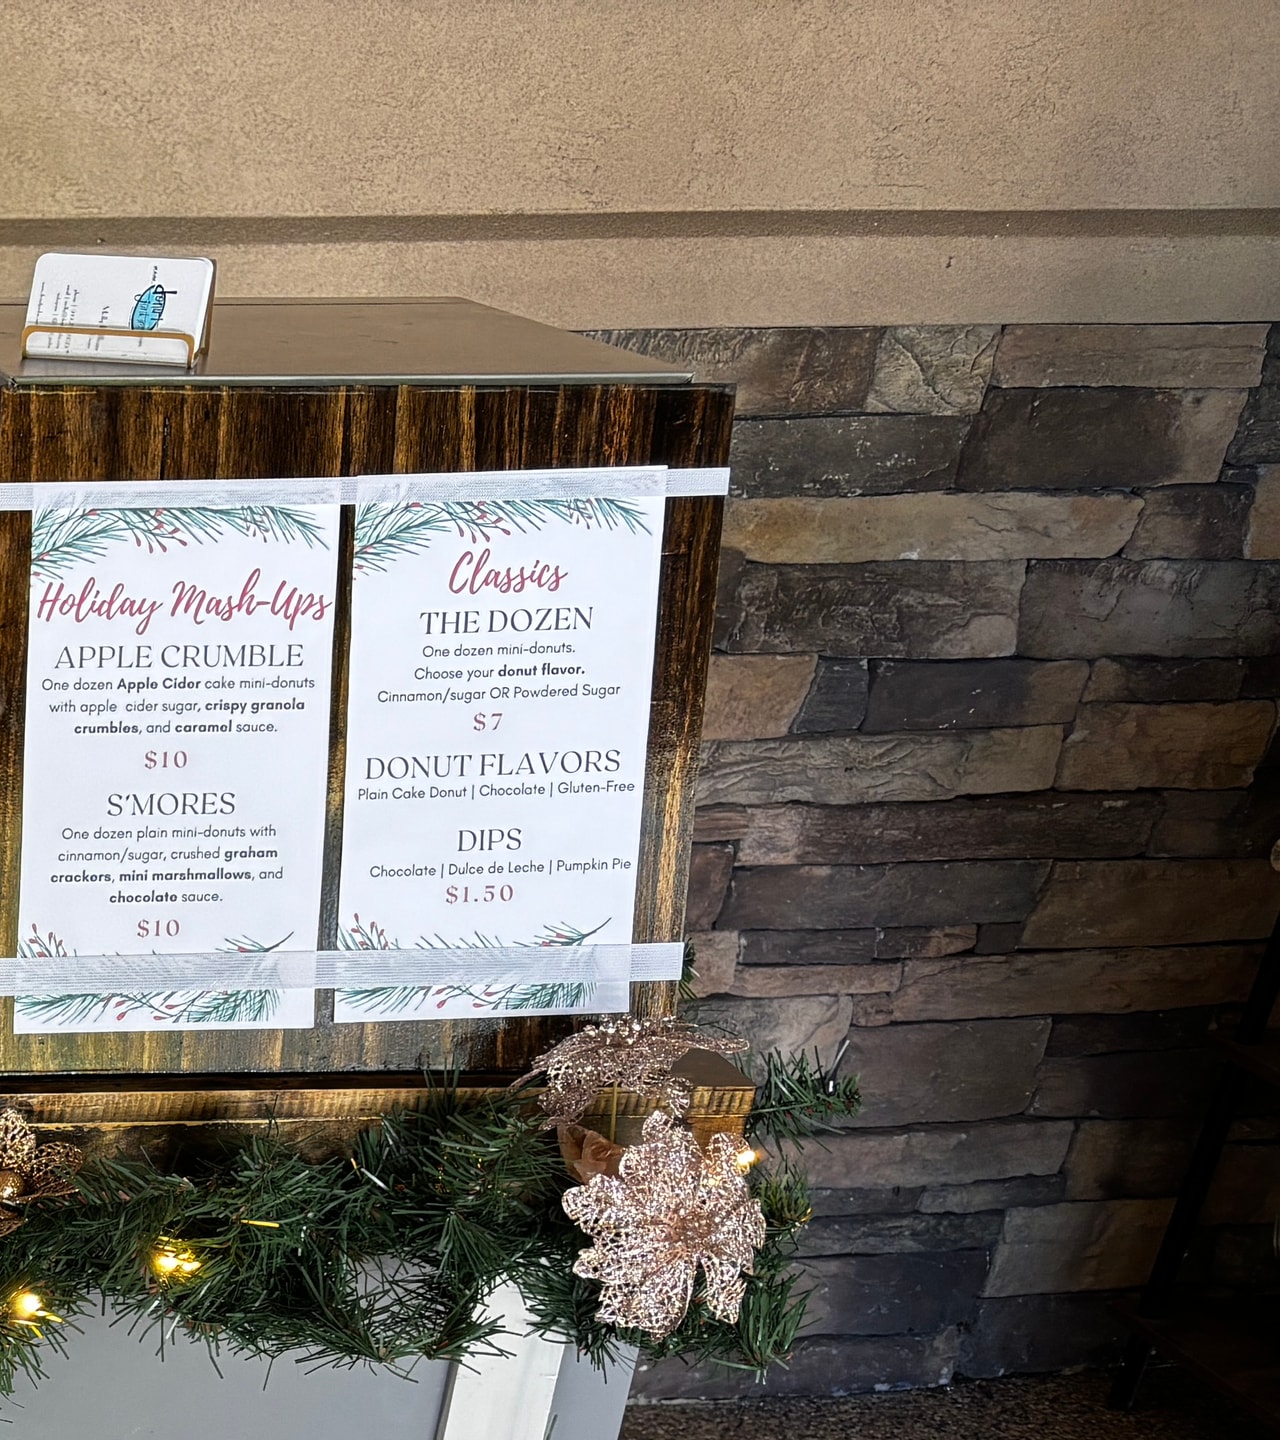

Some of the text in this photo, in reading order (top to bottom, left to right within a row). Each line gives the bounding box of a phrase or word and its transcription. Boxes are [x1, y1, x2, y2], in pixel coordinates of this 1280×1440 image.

[449, 548, 568, 595] Classics
[37, 568, 332, 635] Holiday Mash-Ups
[420, 607, 593, 634] THE DOZEN
[54, 644, 303, 669] APPLE CRUMBLE
[423, 641, 575, 657] One dozen mini-donuts.
[414, 663, 585, 682] Choose your donut flavor.
[42, 675, 315, 693] One dozen Apple Cider cake mini-donuts
[378, 683, 621, 704] Cinnamon/sugar OR Powdered Sugar
[49, 697, 304, 716] with apple cider sugar, crispy granola
[74, 719, 277, 735] crumbles, and caramel sauce.
[474, 712, 502, 731] $7
[145, 750, 187, 769] $10
[366, 750, 620, 779] DONUT FLAVORS
[358, 788, 388, 800] Plain
[392, 786, 425, 799] Cake
[430, 786, 467, 798] Donut
[479, 782, 545, 796] Chocolate
[558, 780, 635, 794] Gluten-Free
[107, 792, 235, 816] S'MORES
[62, 824, 276, 842] One dozen plain mini-donuts with
[458, 828, 521, 851] DIPS
[58, 845, 277, 864] cinnamon/sugar, crushed graham
[51, 866, 283, 883] crackers, mini marshmallows, and
[370, 864, 436, 877] Chocolate
[449, 862, 484, 875] Dulce
[488, 861, 504, 874] de
[509, 860, 544, 873] Leche
[557, 858, 608, 874] Pumpkin
[612, 858, 631, 869] Pie
[109, 890, 223, 903] chocolate sauce.
[446, 885, 513, 904] $1.50
[137, 919, 179, 938] $10
